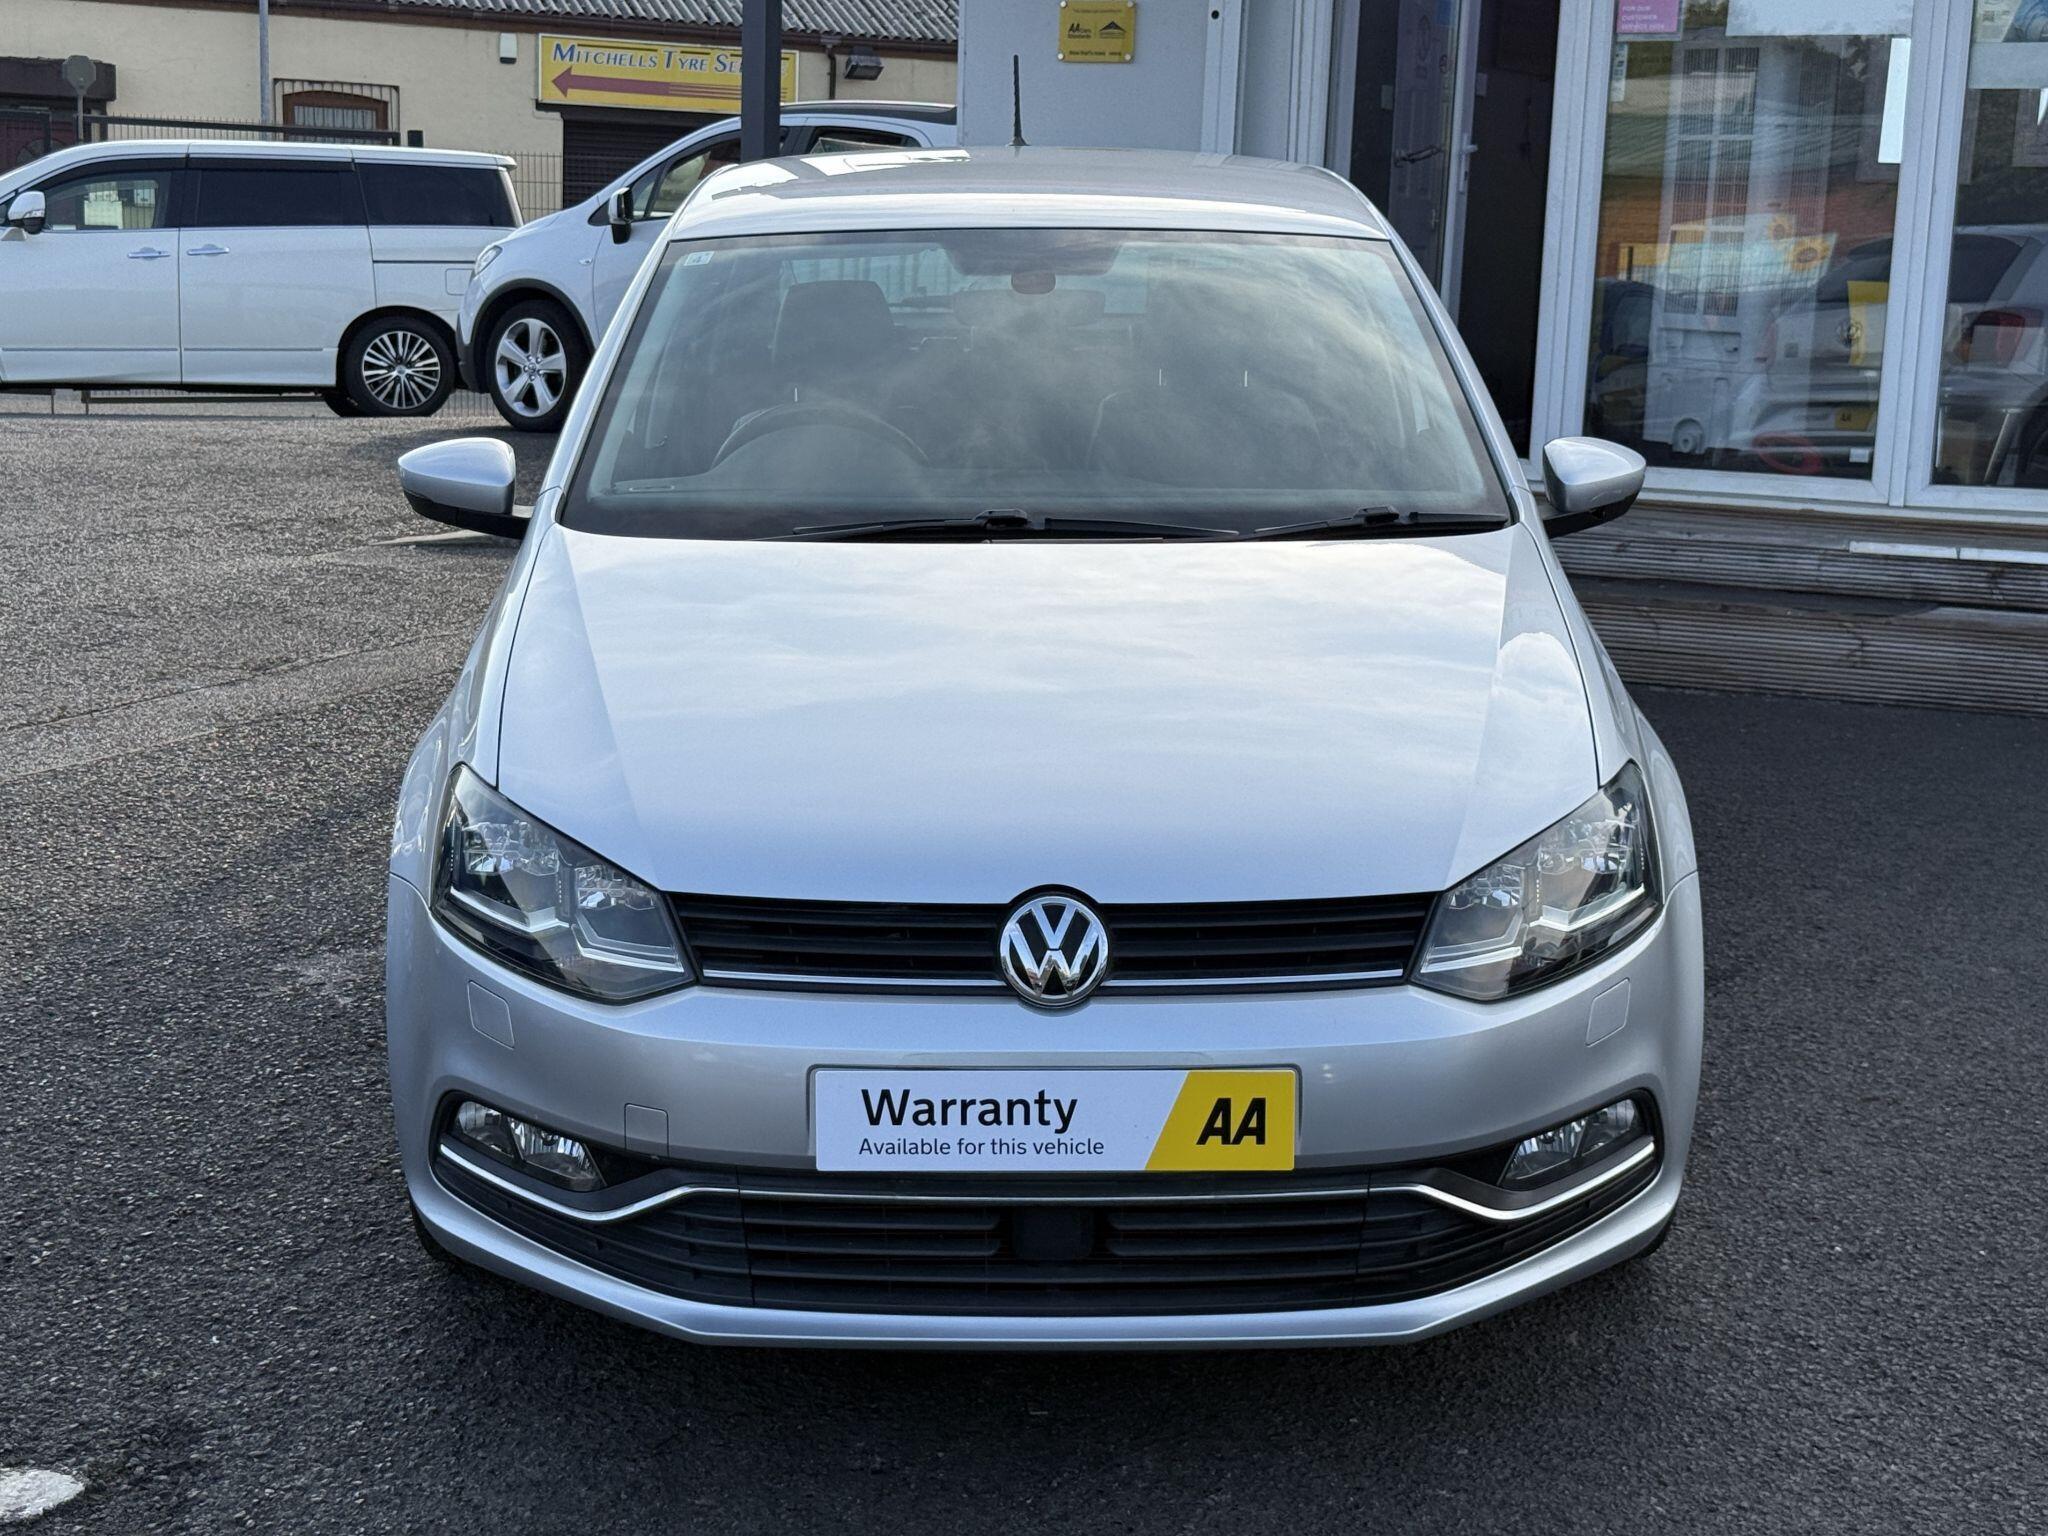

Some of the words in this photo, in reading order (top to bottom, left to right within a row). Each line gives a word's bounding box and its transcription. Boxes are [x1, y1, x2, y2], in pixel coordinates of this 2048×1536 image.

[552, 42, 658, 69] MITCHELLS
[662, 49, 708, 72] TYRE
[860, 1088, 1079, 1135] Warranty
[1195, 1097, 1267, 1146] AA
[858, 1138, 951, 1156] Available
[957, 1138, 986, 1155] for
[991, 1138, 1028, 1155] this
[1032, 1138, 1105, 1156] vehicle
